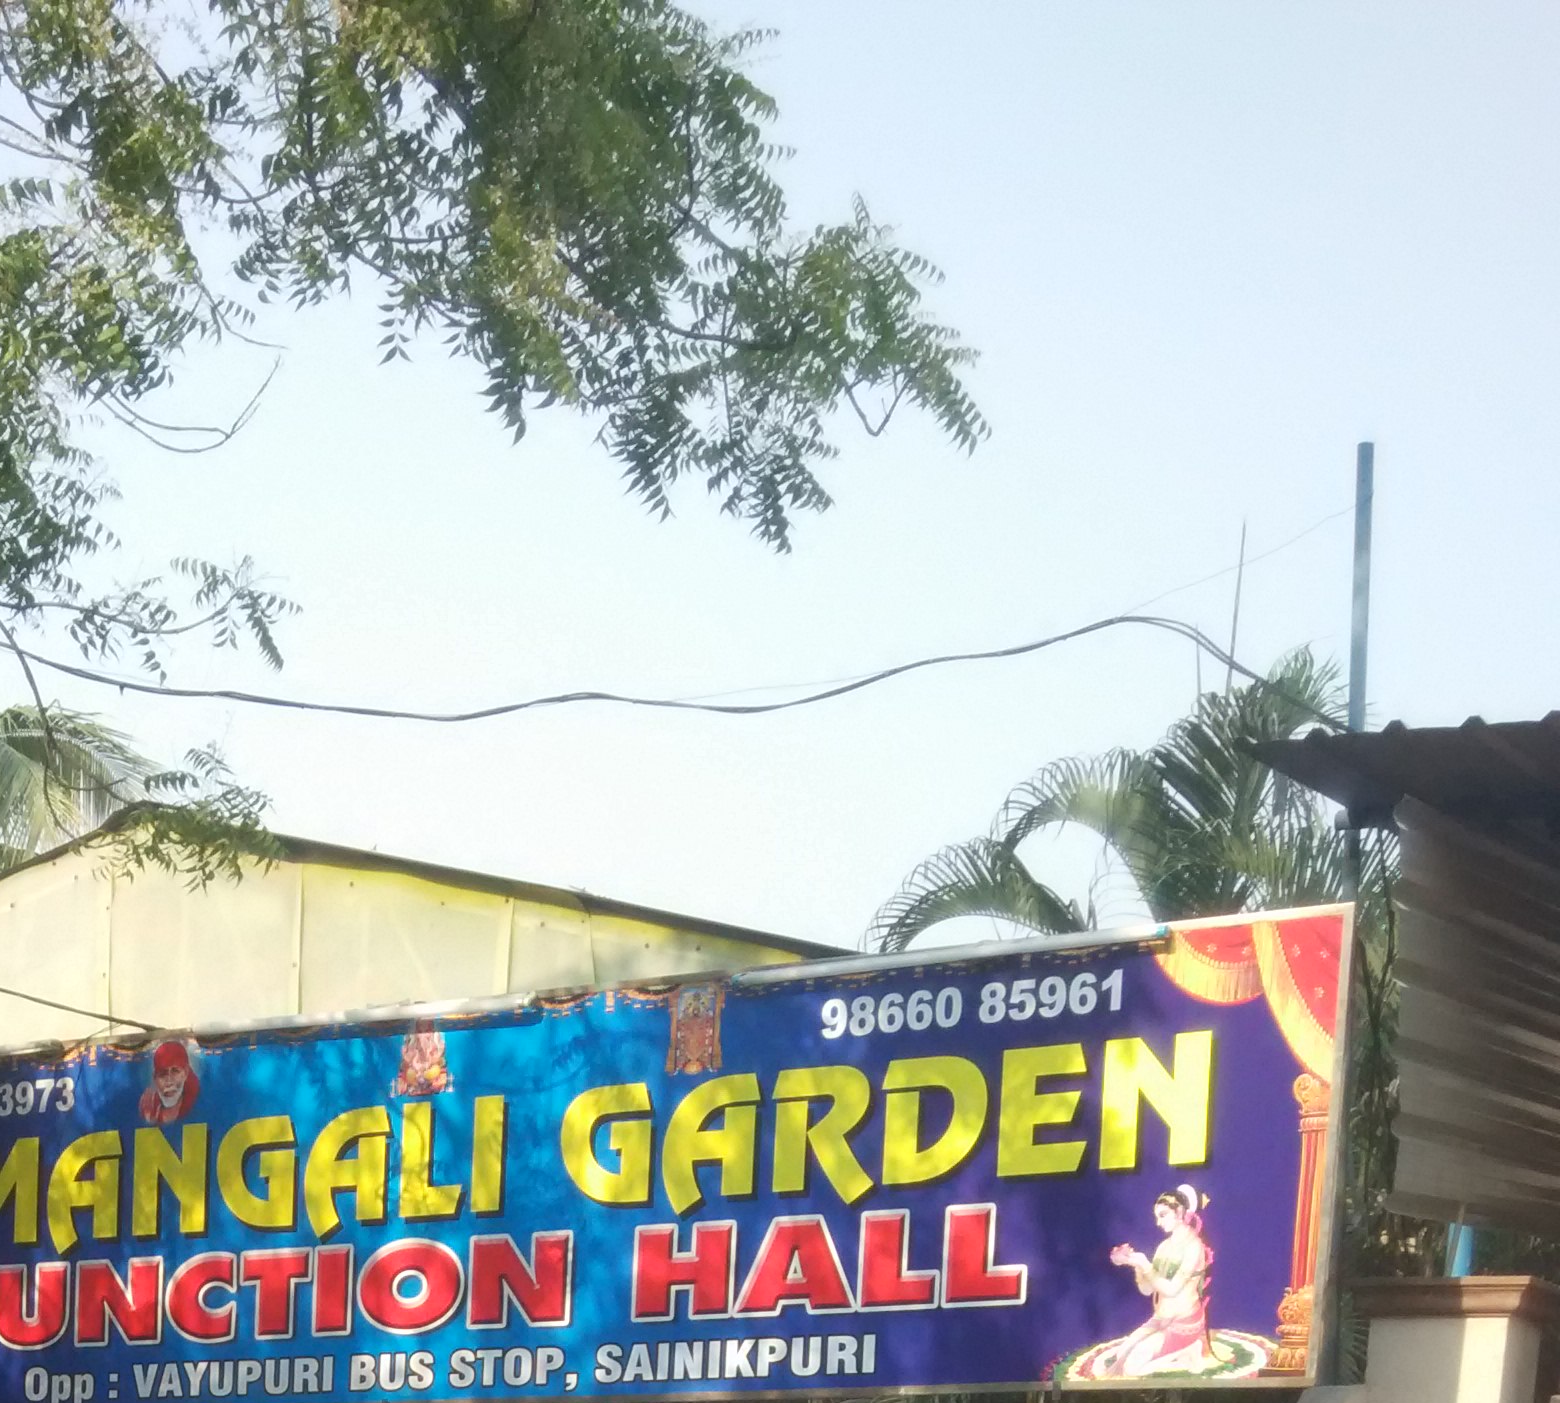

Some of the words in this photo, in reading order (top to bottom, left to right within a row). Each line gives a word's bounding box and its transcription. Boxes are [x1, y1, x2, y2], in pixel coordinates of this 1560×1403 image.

[819, 986, 964, 1041] 98660
[978, 968, 1126, 1026] 85961
[560, 1030, 1214, 1216] GARDEN
[630, 1202, 1029, 1324] HALL
[132, 1354, 335, 1401] VAYUPURI
[348, 1348, 435, 1393] BUS
[447, 1345, 579, 1394] STOP,
[594, 1333, 877, 1385] SAINIKPURI
